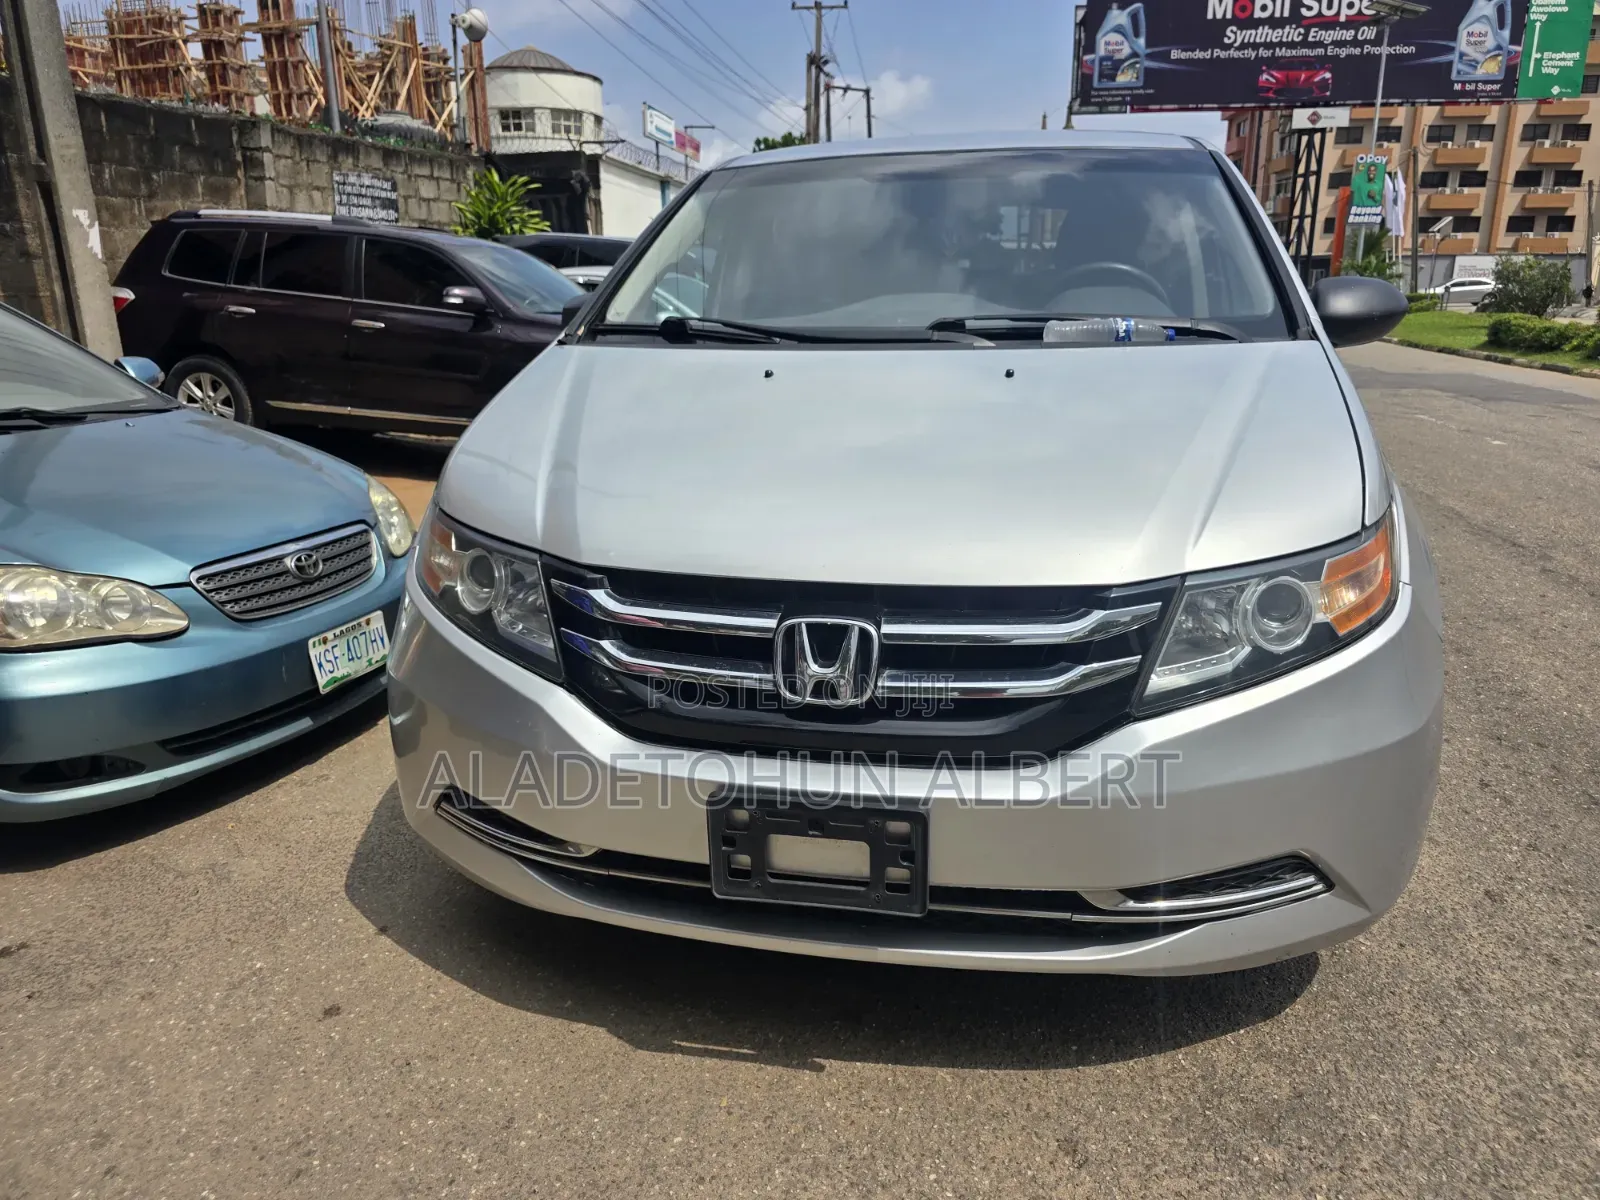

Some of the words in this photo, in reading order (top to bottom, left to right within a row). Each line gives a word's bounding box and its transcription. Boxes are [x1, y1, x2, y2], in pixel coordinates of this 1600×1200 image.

[1206, 0, 1291, 19] Mobil
[1300, 0, 1387, 22] Supe
[1530, 5, 1569, 13] Awolowo
[1529, 13, 1548, 21] Way
[1223, 24, 1305, 47] Synthetic
[1307, 27, 1356, 43] Engine
[1357, 25, 1377, 41] Oil
[1466, 31, 1488, 39] Mobil
[1465, 39, 1487, 47] Super
[1170, 50, 1212, 60] Blended
[1213, 47, 1257, 60] Perfectly
[1258, 47, 1274, 58] for
[1275, 46, 1326, 57] Maximum
[1326, 45, 1362, 58] Engine
[1543, 52, 1581, 60] Elephant
[1541, 66, 1560, 76] Way
[1453, 82, 1476, 92] Mobil
[1477, 82, 1502, 92] Super
[1350, 205, 1383, 215] Beyond
[1347, 214, 1383, 224] Banking
[332, 621, 363, 638] LAGOS
